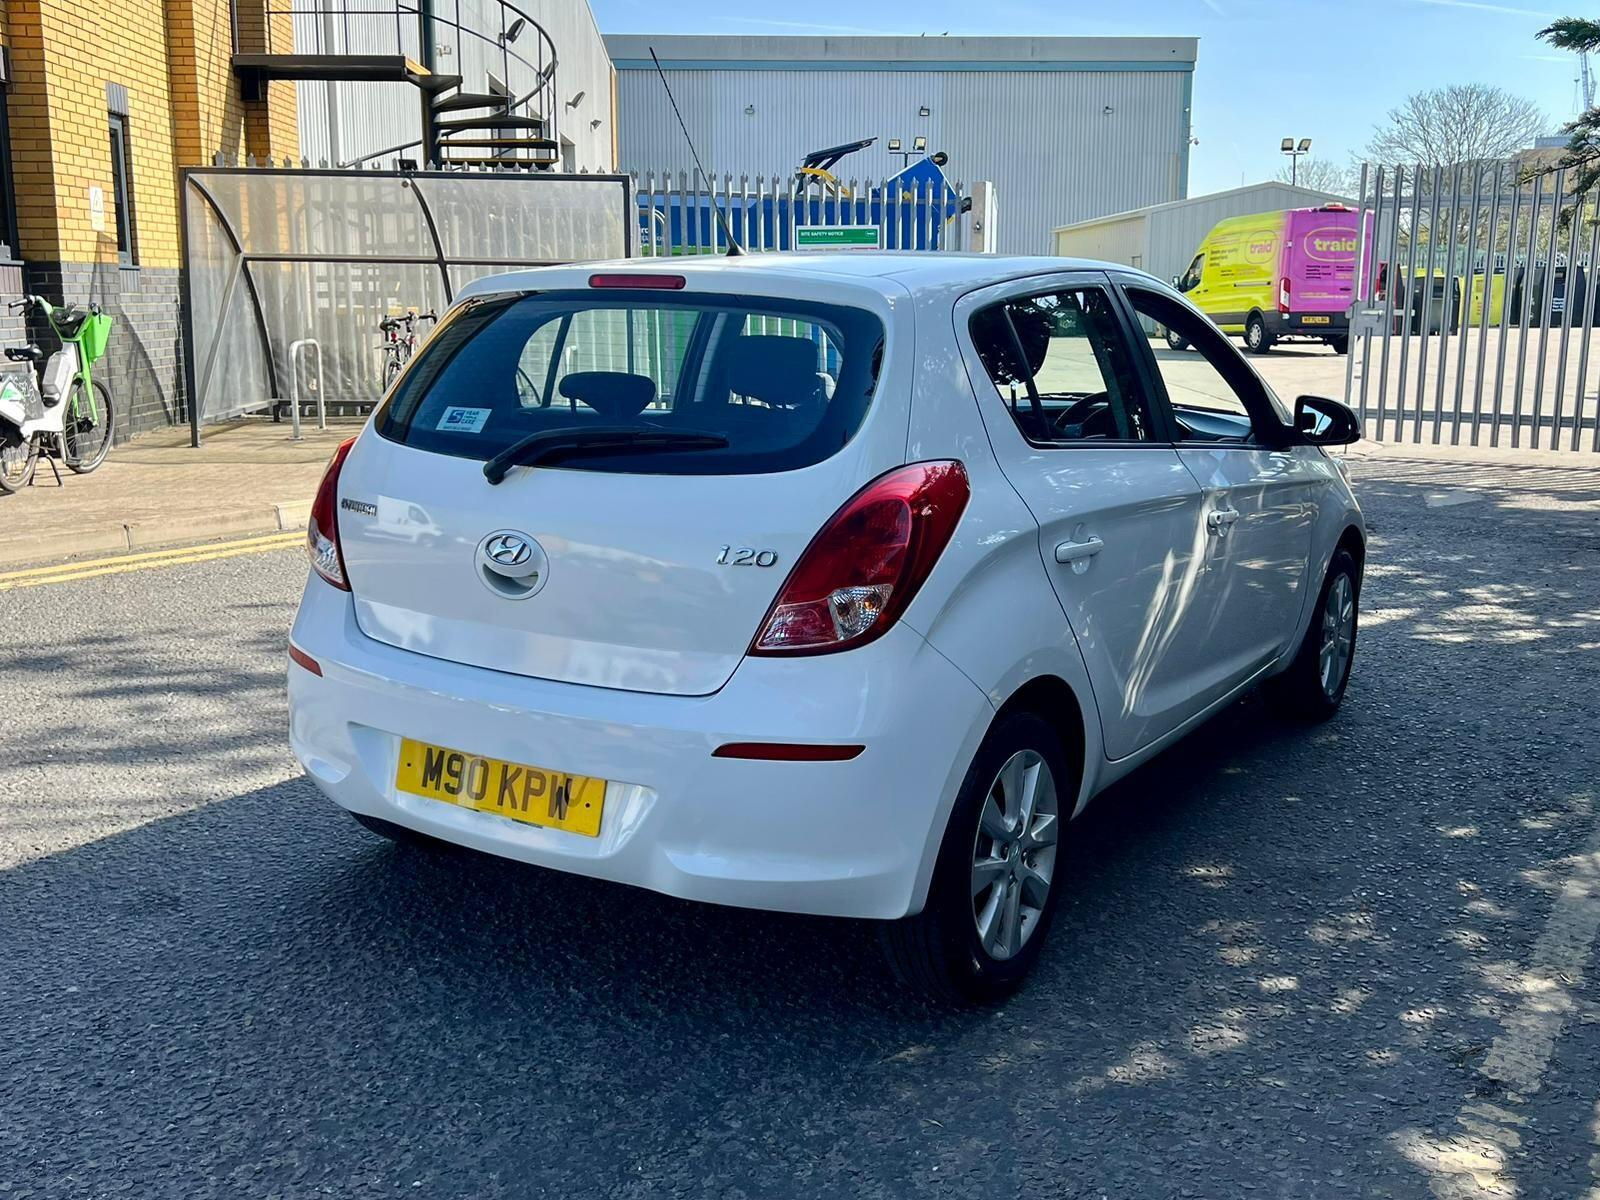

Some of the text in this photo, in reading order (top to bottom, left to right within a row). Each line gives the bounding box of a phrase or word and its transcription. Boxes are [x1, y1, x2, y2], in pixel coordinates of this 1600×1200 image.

[1250, 240, 1272, 254] traid
[1314, 238, 1357, 251] traid
[716, 545, 778, 567] i20
[421, 747, 489, 801] M90
